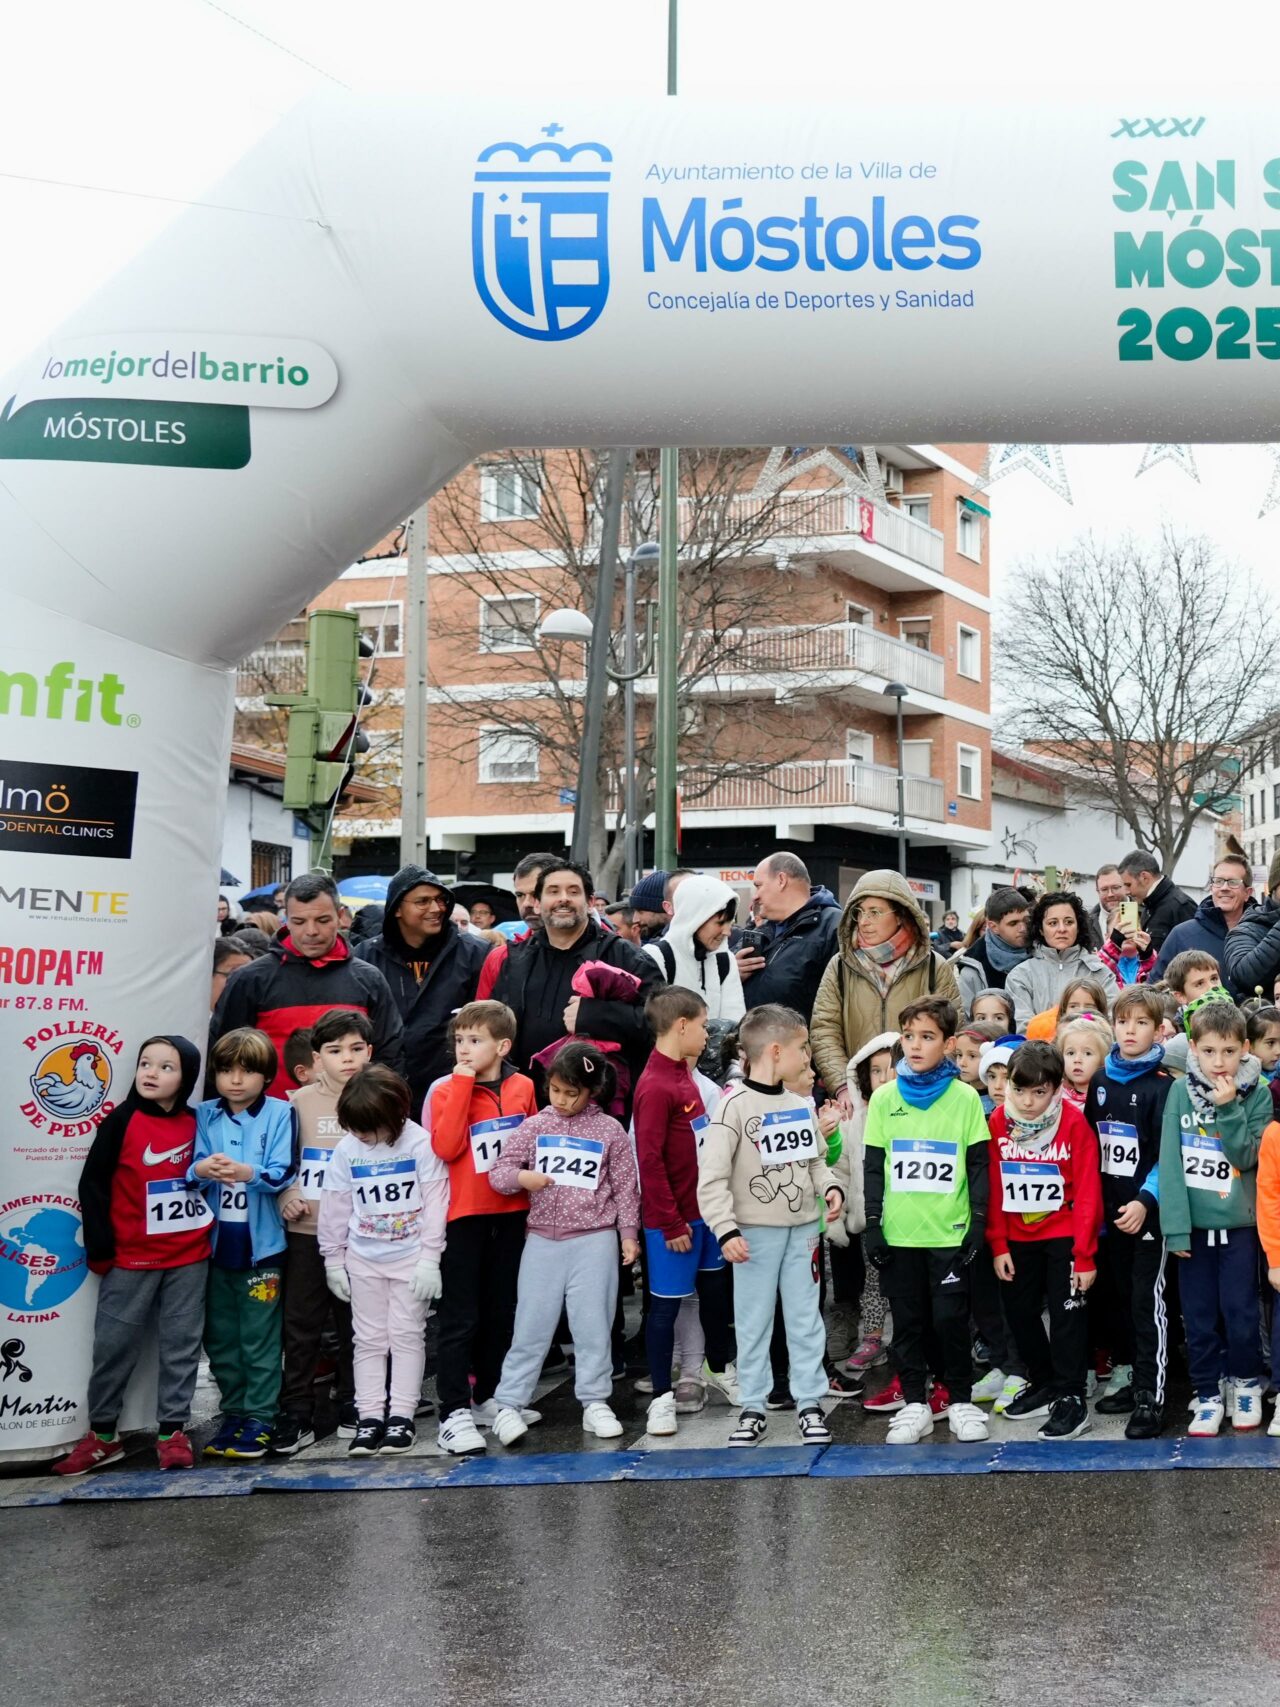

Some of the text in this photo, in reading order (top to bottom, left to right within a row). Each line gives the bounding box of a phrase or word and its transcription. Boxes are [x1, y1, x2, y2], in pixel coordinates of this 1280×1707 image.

[1110, 116, 1206, 138] XXXI
[645, 161, 937, 185] Ayuntamiento de la Villa de
[1111, 159, 1236, 221] SAN
[642, 195, 982, 273] Móstoles
[647, 289, 975, 312] Concejalía de Deportes y Sanidad
[42, 350, 309, 386] lomejordelbarrio
[43, 411, 187, 445] MÓSTOLES
[15, 996, 53, 1010] 87.8
[59, 998, 88, 1011] FM.
[22, 1020, 125, 1054] POLLERÍA
[20, 1100, 114, 1137] DE PEDRO
[317, 1120, 343, 1134] SK
[761, 1128, 813, 1154] 1299
[538, 1155, 598, 1179] 1242
[894, 1160, 954, 1182] 1202
[1185, 1156, 1230, 1180] 258
[357, 1181, 415, 1205] 1187
[1005, 1182, 1062, 1201] 1172
[151, 1198, 207, 1221] 1206
[0, 1239, 57, 1267] LISES
[7, 1311, 60, 1323] LATINA
[25, 1420, 38, 1429] DE
[41, 1416, 77, 1428] BELLEZA
